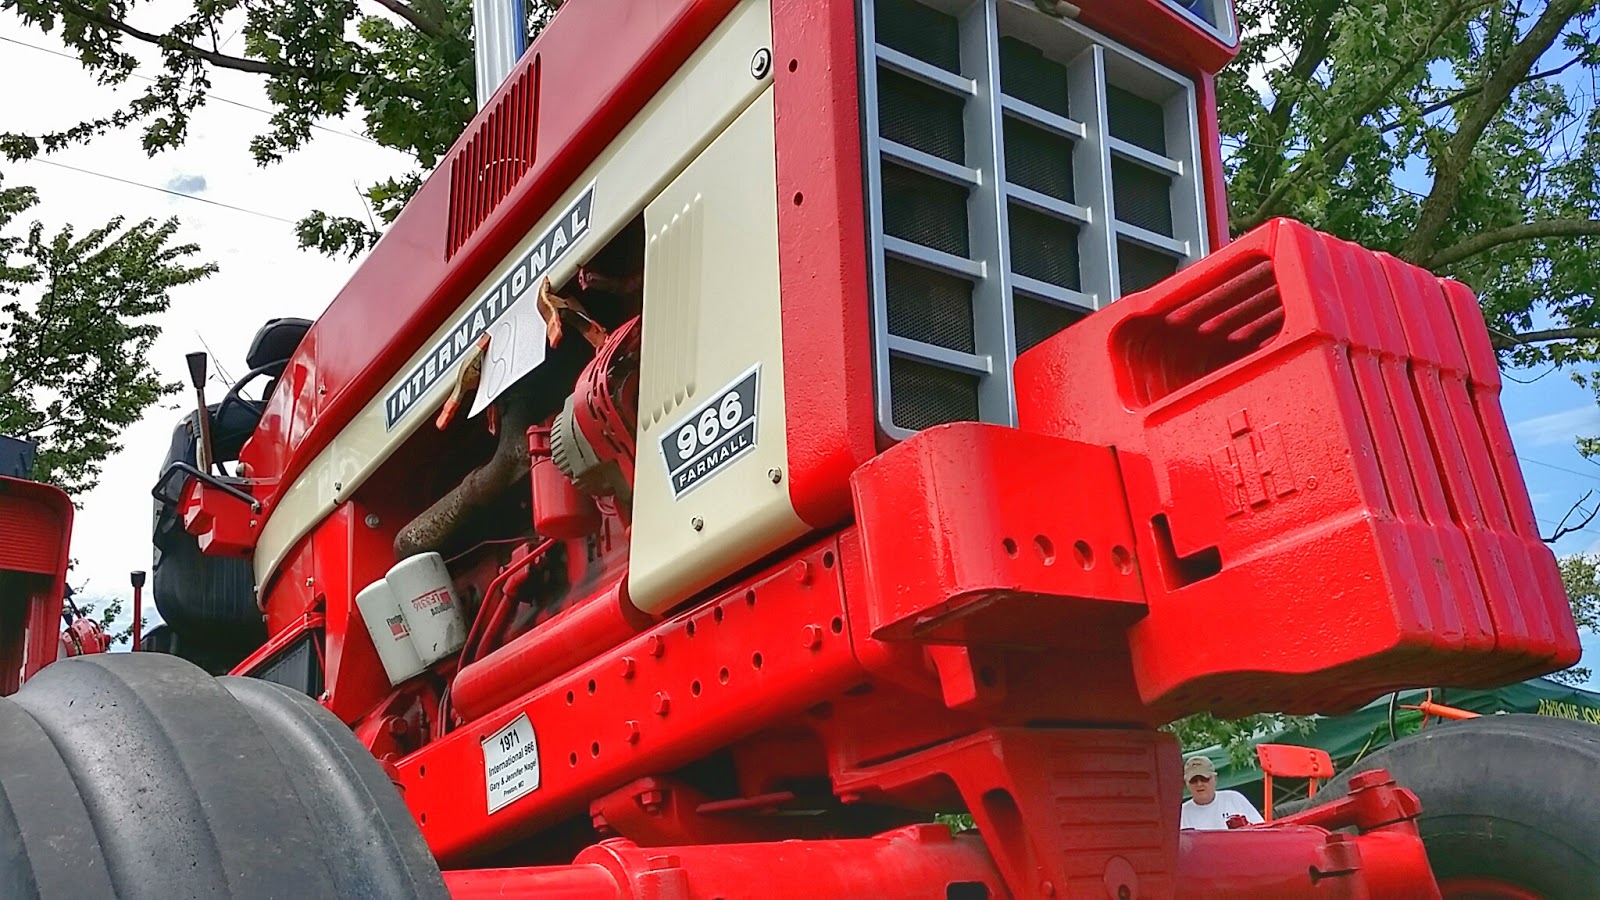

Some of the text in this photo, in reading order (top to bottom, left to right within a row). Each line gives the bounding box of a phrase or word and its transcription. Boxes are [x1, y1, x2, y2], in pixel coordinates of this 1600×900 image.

[389, 208, 587, 420] INTERNATIONAL
[677, 391, 743, 460] 966
[679, 434, 748, 487] FARMALL
[488, 741, 535, 777] International 966
[499, 728, 520, 753] 1971
[489, 781, 501, 792] Gary
[505, 767, 524, 782] Jennifer
